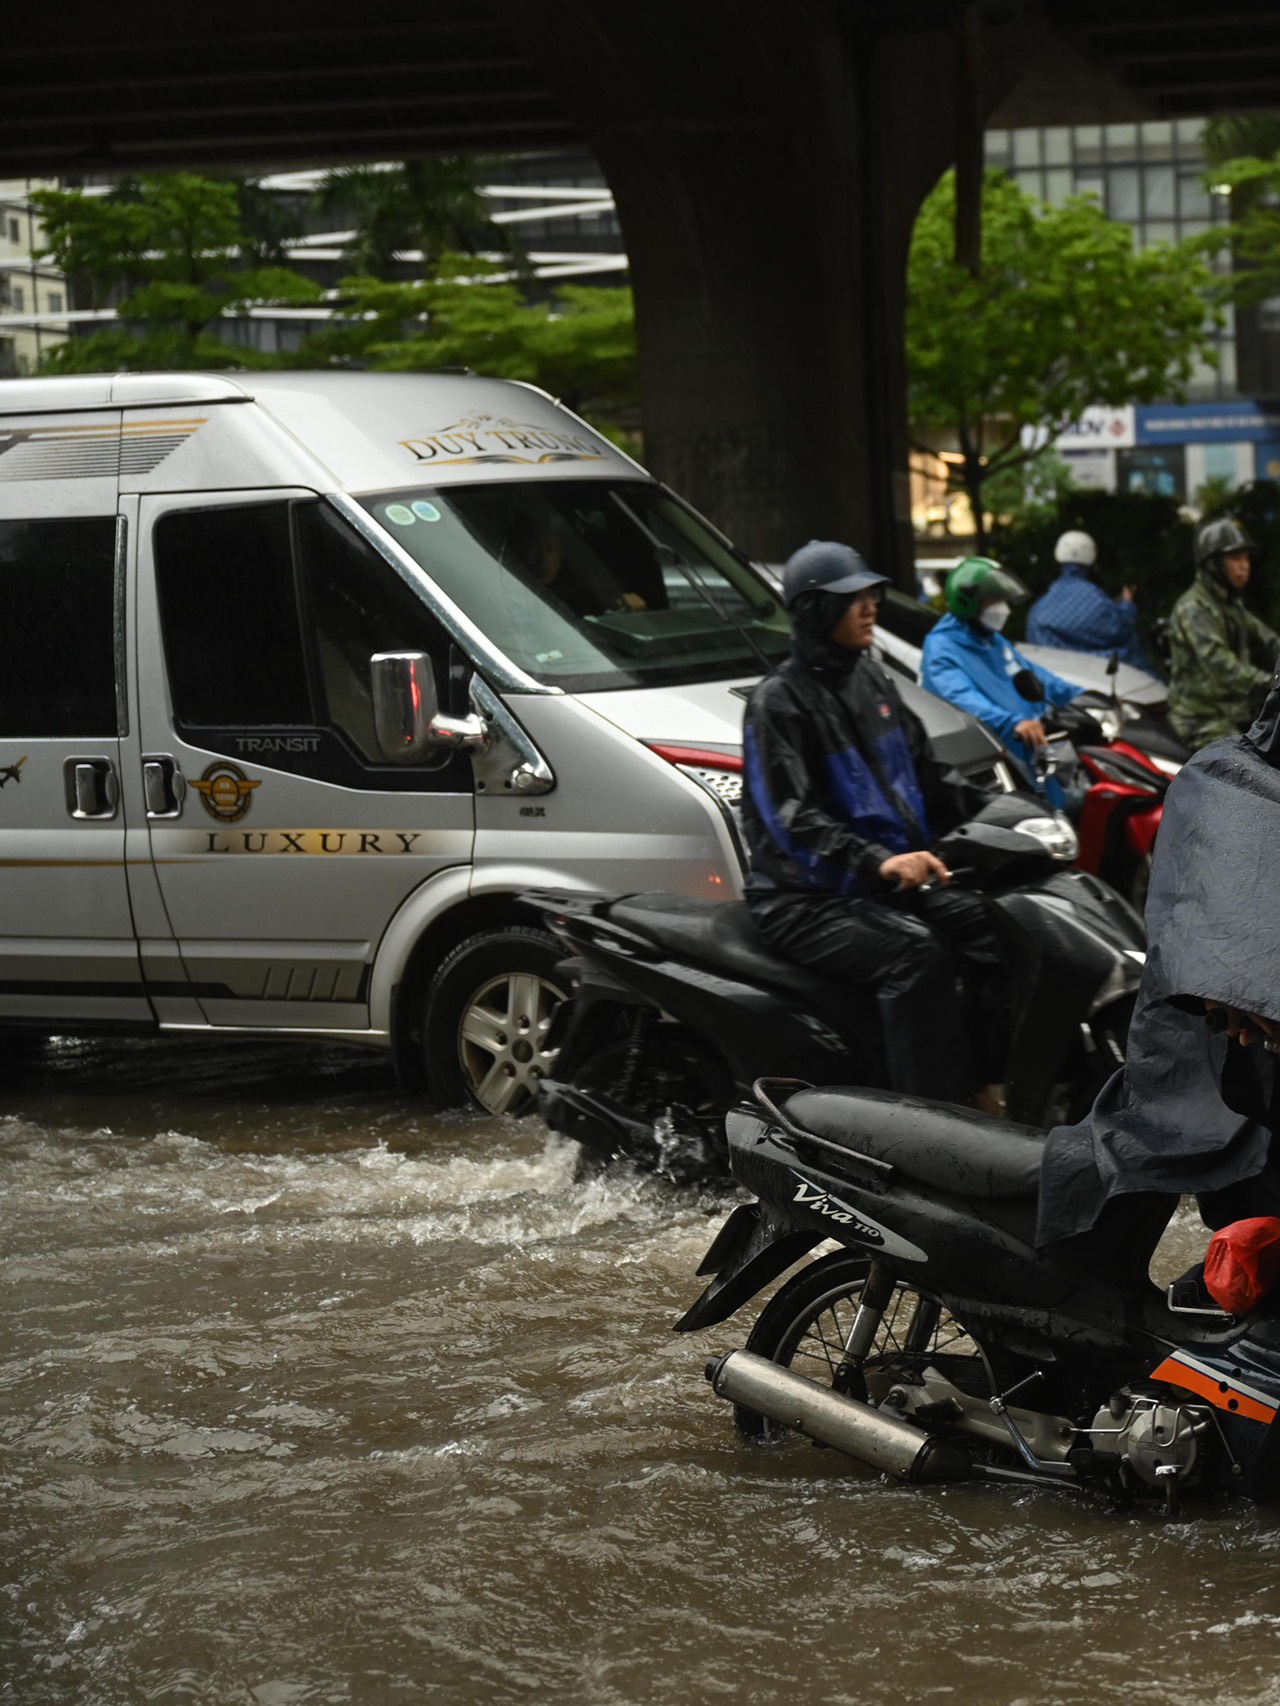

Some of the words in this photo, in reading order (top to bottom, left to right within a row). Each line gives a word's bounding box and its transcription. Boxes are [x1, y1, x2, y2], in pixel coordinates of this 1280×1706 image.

[399, 431, 487, 460] DUY
[485, 430, 601, 456] TRUNG
[235, 737, 321, 752] TRANSIT
[205, 832, 421, 853] LUXURY
[792, 1183, 855, 1225] Viva
[853, 1221, 881, 1238] 110
